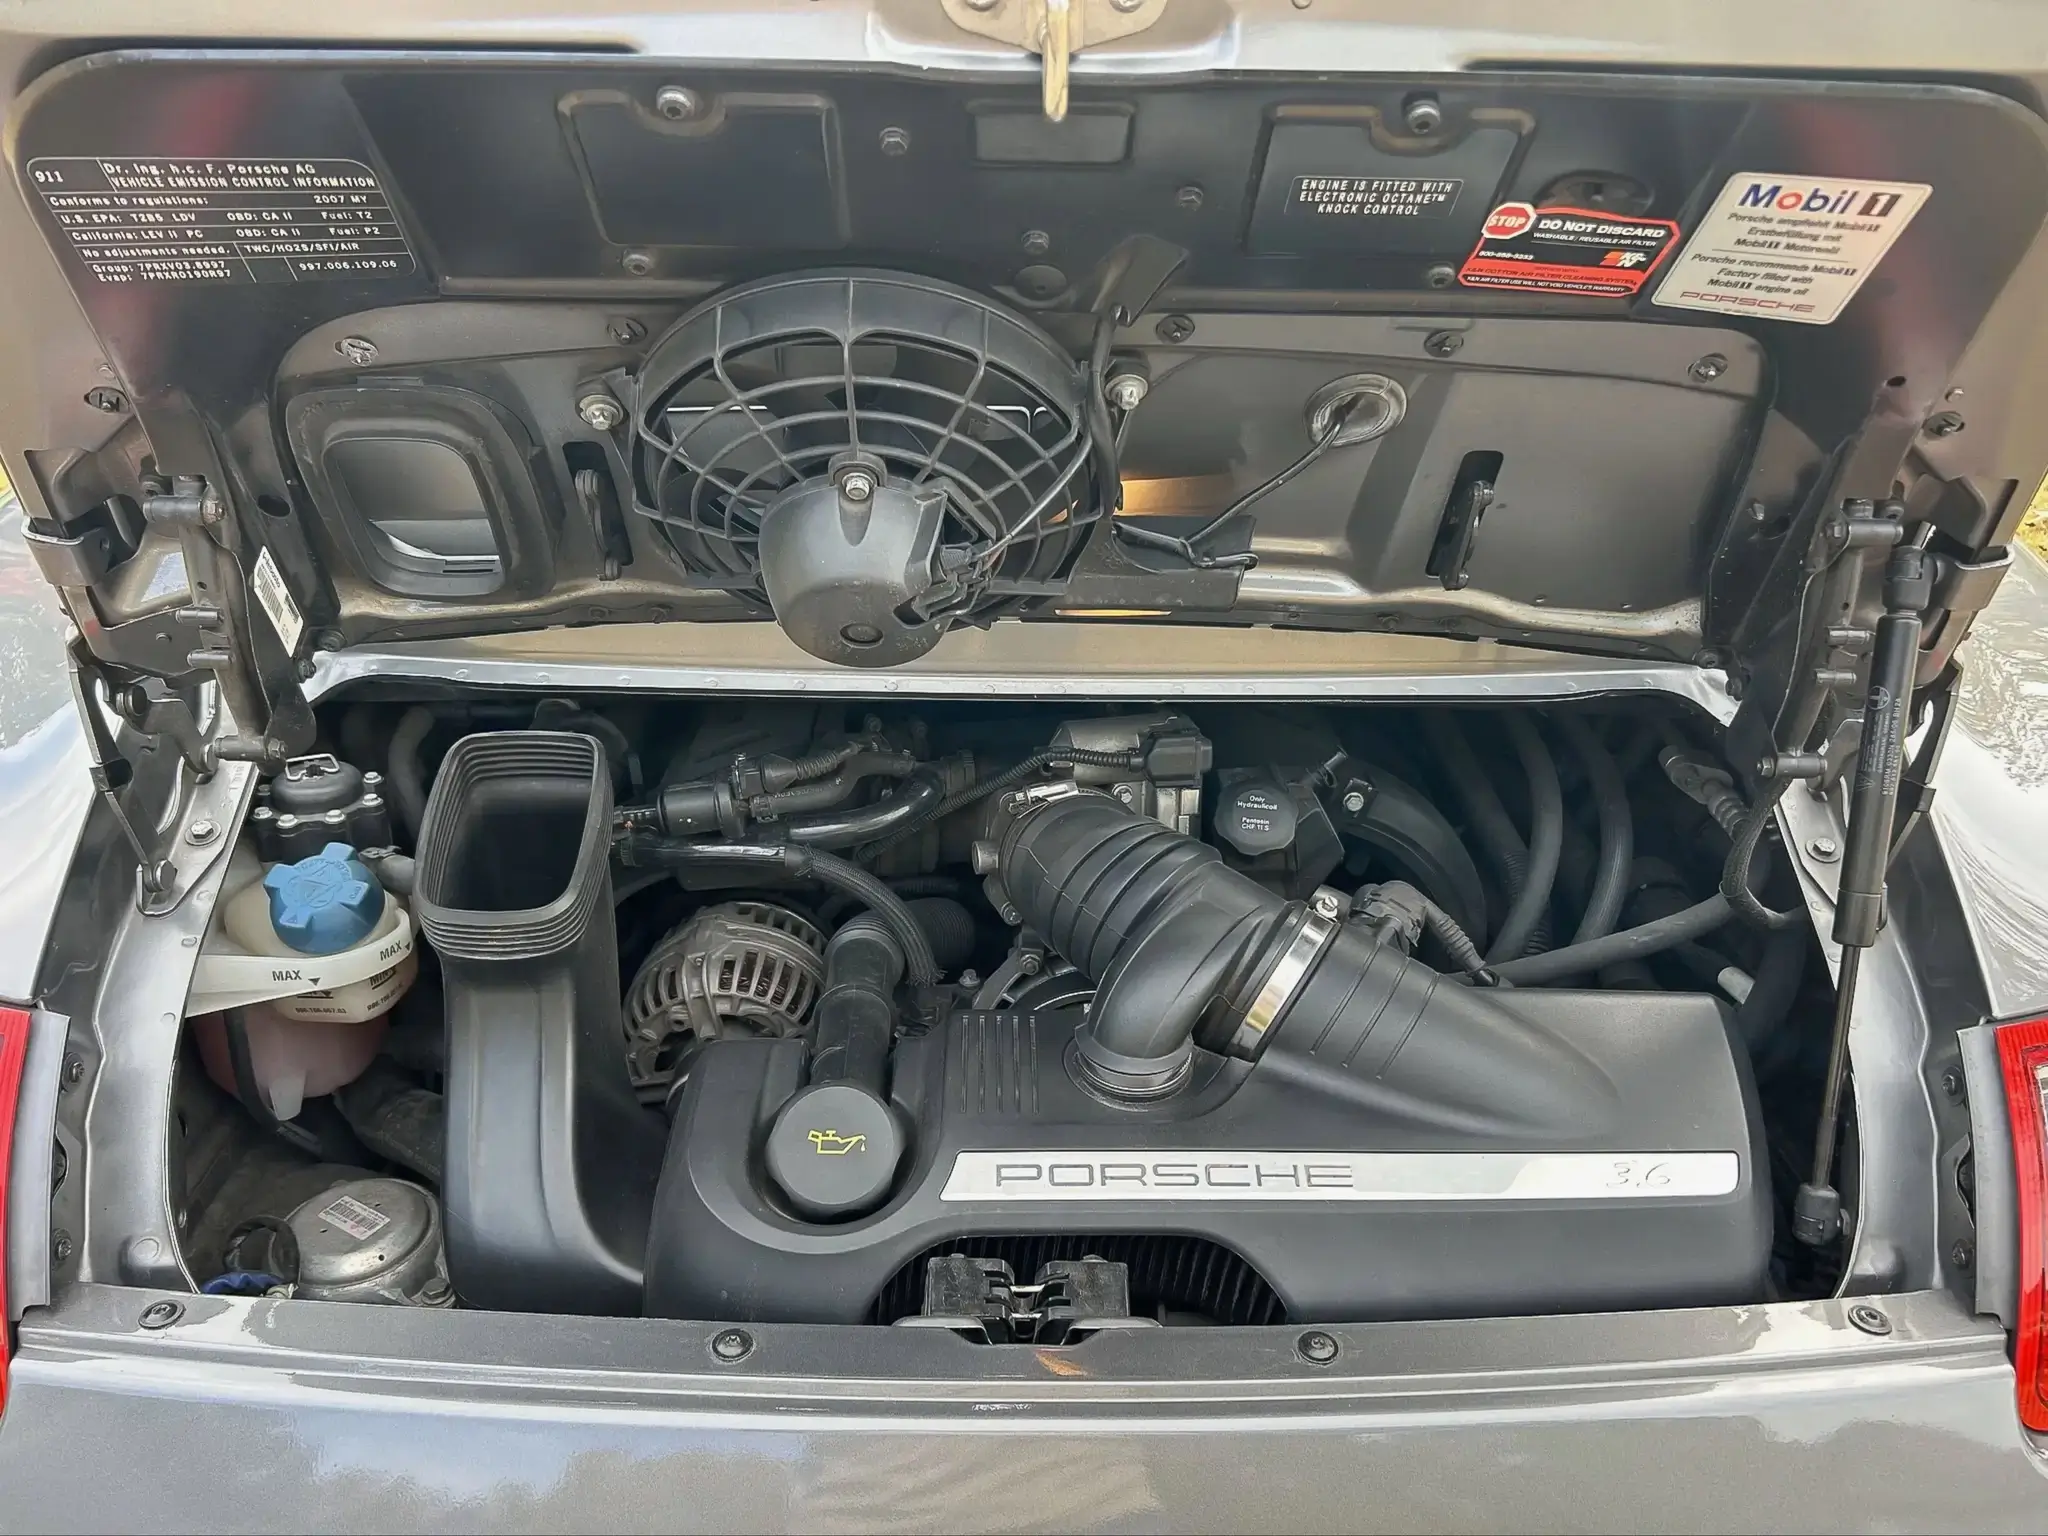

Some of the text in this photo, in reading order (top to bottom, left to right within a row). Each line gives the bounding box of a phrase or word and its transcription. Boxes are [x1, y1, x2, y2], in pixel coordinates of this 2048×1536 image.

[103, 163, 316, 176] Dr. Ing. h.c. F. Porsche AG
[35, 170, 63, 183] 911
[110, 177, 375, 188] VEHICLE EMISSION CONTROL INFORMATION
[1301, 179, 1453, 193] ENGINE IS FITTED WITH
[49, 195, 368, 207] Conforms to regulations: 2007 MY
[1299, 191, 1377, 202] ELECTRONIC
[1738, 183, 1898, 217] Mobil 1
[1317, 203, 1420, 216] KNOCK CONTROL
[60, 211, 373, 224] U.S. EPA: T2B5 LDV OBD: CA II Fuel: T2
[1488, 214, 1527, 227] STOP
[1727, 212, 1773, 223] Porsche
[71, 227, 380, 241] California: LEV II PC OBD: CA II Fuel: P2
[1538, 219, 1666, 238] DO NOT DISCARD
[1533, 232, 1575, 242] WASHABLE
[1579, 236, 1618, 244] REUSABLE
[1631, 239, 1656, 247] FILTER
[1734, 238, 1767, 248] Mobil
[81, 245, 230, 259] No adjustments needed.
[92, 264, 134, 273] Group:
[299, 260, 397, 271] 997.006.109.06
[1691, 253, 1737, 264] Porsche
[1811, 264, 1845, 274] Mobil
[98, 272, 133, 283] Evap:
[1484, 268, 1518, 276] COTTON
[1561, 274, 1602, 282] CLEANING
[1717, 267, 1814, 284] Factory filled with
[1707, 278, 1740, 288] Mobil
[1754, 285, 1791, 294] engine
[1679, 291, 1816, 313] PORSCHE
[1249, 795, 1266, 803] Only
[1242, 817, 1270, 825] Pentosin
[379, 940, 403, 961] MAX
[272, 970, 302, 982] MAX
[996, 1163, 1353, 1188] PORSCHE
[1606, 1160, 1671, 1188] 3.6
